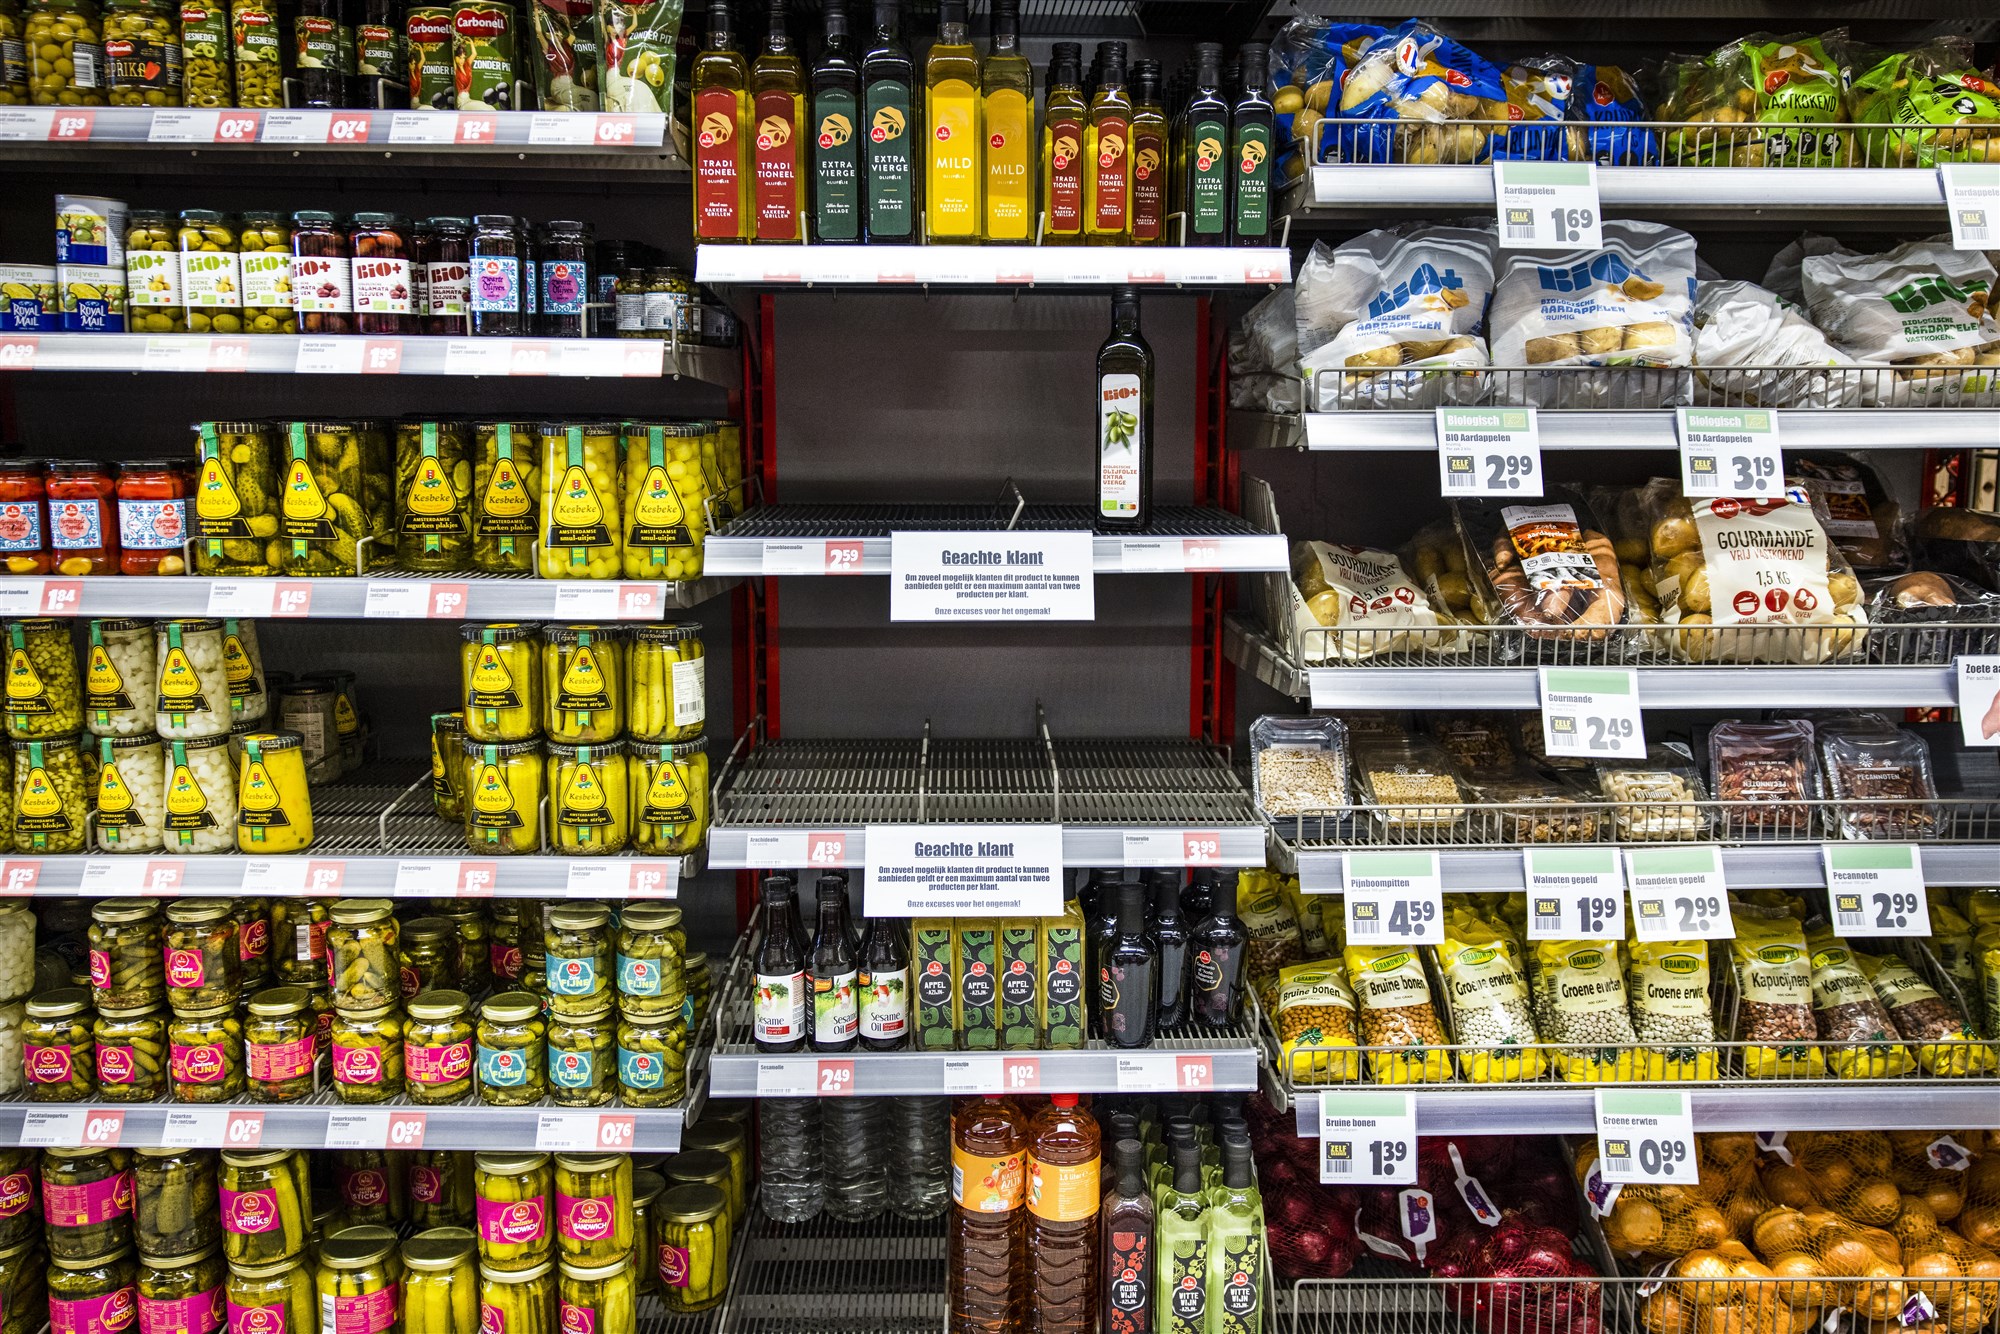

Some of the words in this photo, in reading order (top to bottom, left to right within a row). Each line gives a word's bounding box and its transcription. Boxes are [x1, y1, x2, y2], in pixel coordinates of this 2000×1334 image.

[457, 17, 504, 30] Carbonell
[247, 36, 277, 45] GESNEDEN
[629, 30, 652, 42] ZONDER
[659, 33, 672, 44] PIT
[936, 157, 972, 169] MILD
[700, 168, 736, 176] TIONEEL
[819, 169, 855, 177] VIERGE
[1504, 186, 1556, 197] Aardappelen
[1510, 211, 1528, 221] ZELF
[1541, 299, 1595, 308] BIOLOGISCHE
[80, 302, 107, 318] ROYAL
[81, 316, 105, 328] MAIL
[1447, 415, 1500, 428] Biologisch
[1689, 415, 1742, 429] Biologisch
[1446, 433, 1459, 442] BIO
[1460, 433, 1511, 444] Aardappelen
[1688, 434, 1701, 442] BIO
[1702, 434, 1752, 444] Aardappelen
[413, 494, 450, 503] Kesbeke
[560, 505, 597, 514] Kesbeke
[1717, 529, 1815, 549] GOURMANDE
[942, 550, 1002, 565] Geachte
[1007, 550, 1043, 565] klant
[1730, 550, 1750, 562] VRIJ
[1753, 549, 1805, 562] VASTKOKEND
[942, 574, 974, 582] mogelijk
[975, 574, 1002, 582] klanten
[1004, 574, 1013, 582] dit
[1015, 574, 1043, 582] product
[1756, 571, 1773, 586] 1,5
[1777, 571, 1791, 585] KG
[904, 582, 942, 590] aanbieden
[944, 582, 963, 591] geldt
[956, 591, 994, 599] producten
[1009, 591, 1028, 599] klant.
[1015, 608, 1050, 616] ongemak!
[1965, 663, 1990, 674] Zoete
[164, 678, 195, 687] Kesbeke
[568, 676, 600, 685] Kesbeke
[1548, 693, 1593, 704] Gourmande
[915, 842, 973, 856] Geachte
[978, 842, 1014, 856] klant
[915, 866, 946, 874] mogelijk
[947, 866, 974, 874] klanten
[975, 866, 984, 874] dit
[986, 866, 1013, 874] product
[1023, 866, 1049, 874] kunnen
[878, 874, 915, 882] aanbieden
[917, 874, 935, 883] geldt
[1533, 875, 1570, 884] Walnoten
[1571, 874, 1598, 886] gepeld
[1635, 877, 1677, 886] Amandelen
[1679, 875, 1705, 886] gepeld
[1833, 871, 1878, 881] Pecannoten
[929, 883, 965, 891] producten
[980, 883, 999, 891] klant.
[1351, 878, 1410, 889] Pijnboompitten
[986, 900, 1020, 908] ongemak!
[1665, 959, 1697, 971] BRANDWIJK
[560, 978, 590, 988] FIJNE
[924, 981, 946, 989] APPEL
[1752, 972, 1810, 991] Kapucijners
[1370, 979, 1401, 996] Bruine
[1402, 978, 1425, 990] bonen
[1648, 984, 1681, 999] Groene
[871, 1011, 900, 1021] Sesame
[871, 1022, 881, 1031] Oil
[35, 1066, 65, 1075] COCKTAIL
[188, 1064, 220, 1074] FIJNE
[1326, 1118, 1351, 1128] Bruine
[1353, 1119, 1376, 1128] bonen
[1603, 1116, 1631, 1126] Groene
[1632, 1117, 1658, 1126] erwten
[237, 1217, 269, 1227] STICKS
[573, 1221, 607, 1232] SANDWICH
